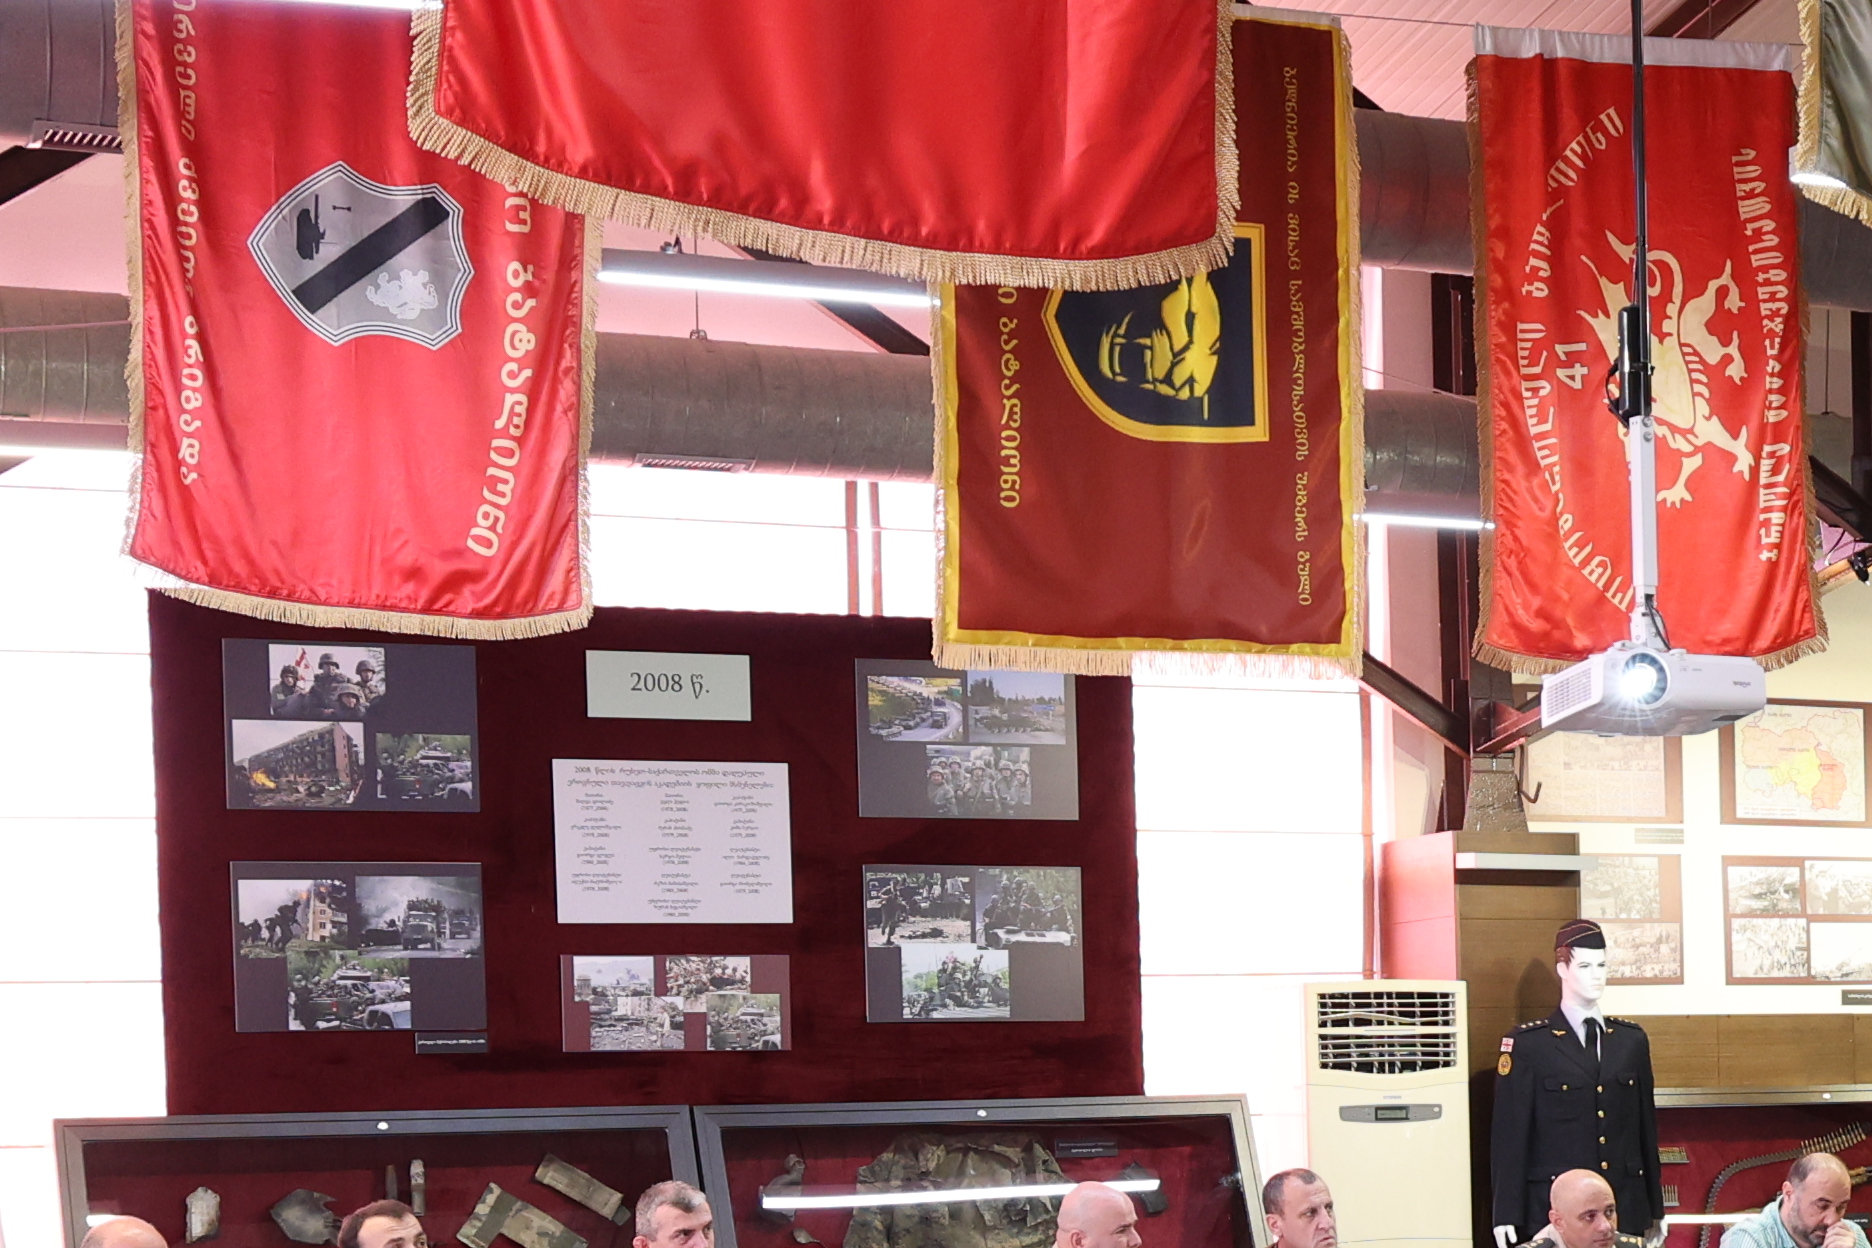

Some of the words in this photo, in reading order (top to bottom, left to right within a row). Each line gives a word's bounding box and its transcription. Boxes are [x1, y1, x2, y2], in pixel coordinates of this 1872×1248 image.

[466, 260, 538, 557] ბატალიონი
[998, 317, 1022, 508] ბატალიონი
[1554, 342, 1590, 390] 41
[630, 671, 684, 693] 2008
[689, 672, 711, 700] წ.
